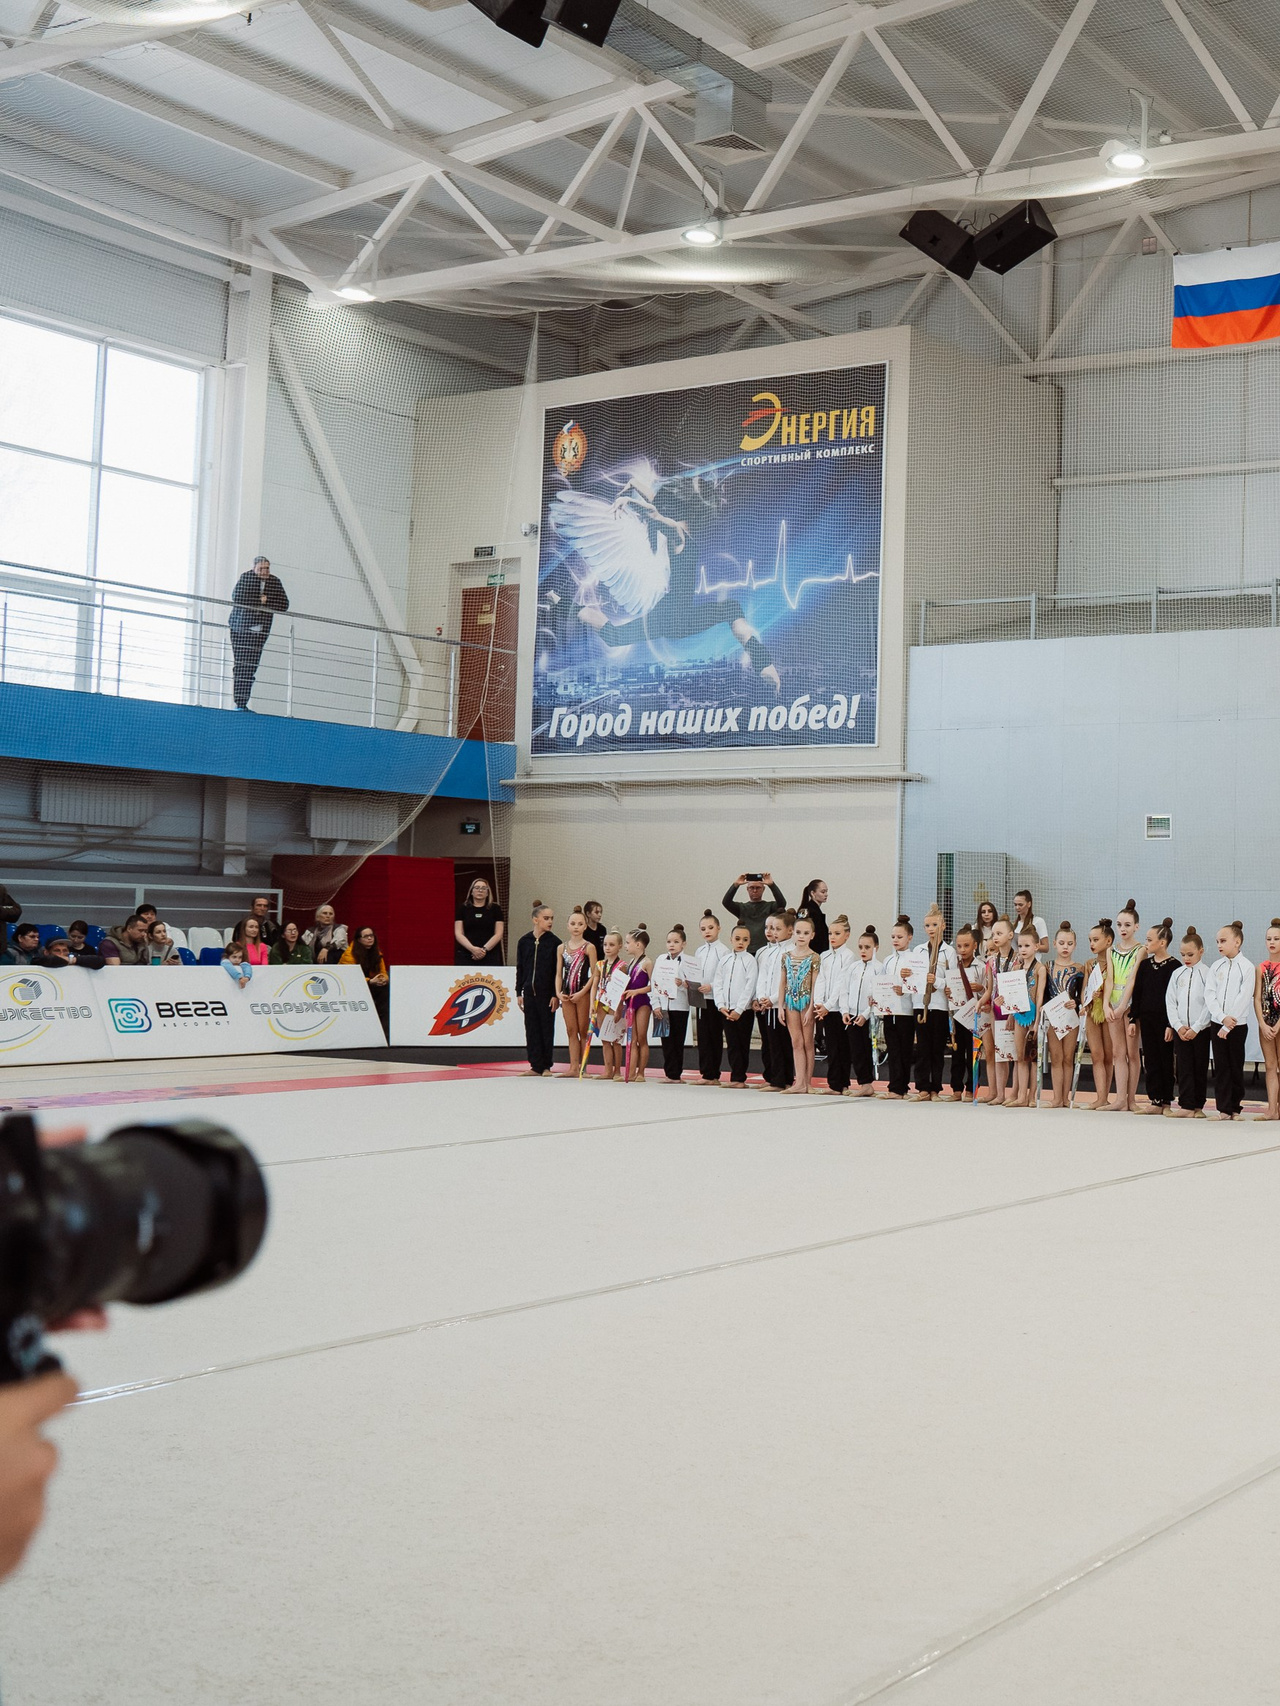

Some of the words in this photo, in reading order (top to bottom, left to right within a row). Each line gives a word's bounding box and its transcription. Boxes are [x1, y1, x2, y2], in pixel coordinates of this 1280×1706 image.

[740, 449, 811, 466] СПОРТИВНЫЙ
[816, 444, 875, 459] КОМПЛЕКС
[548, 703, 633, 746] Город
[639, 706, 743, 735] наших
[748, 694, 861, 731] побед!
[249, 1000, 369, 1015] СОДРУЖЕСТВО
[457, 977, 496, 989] ТРУДОВЫЕ
[495, 984, 506, 1014] РЕЗЕРВЫ
